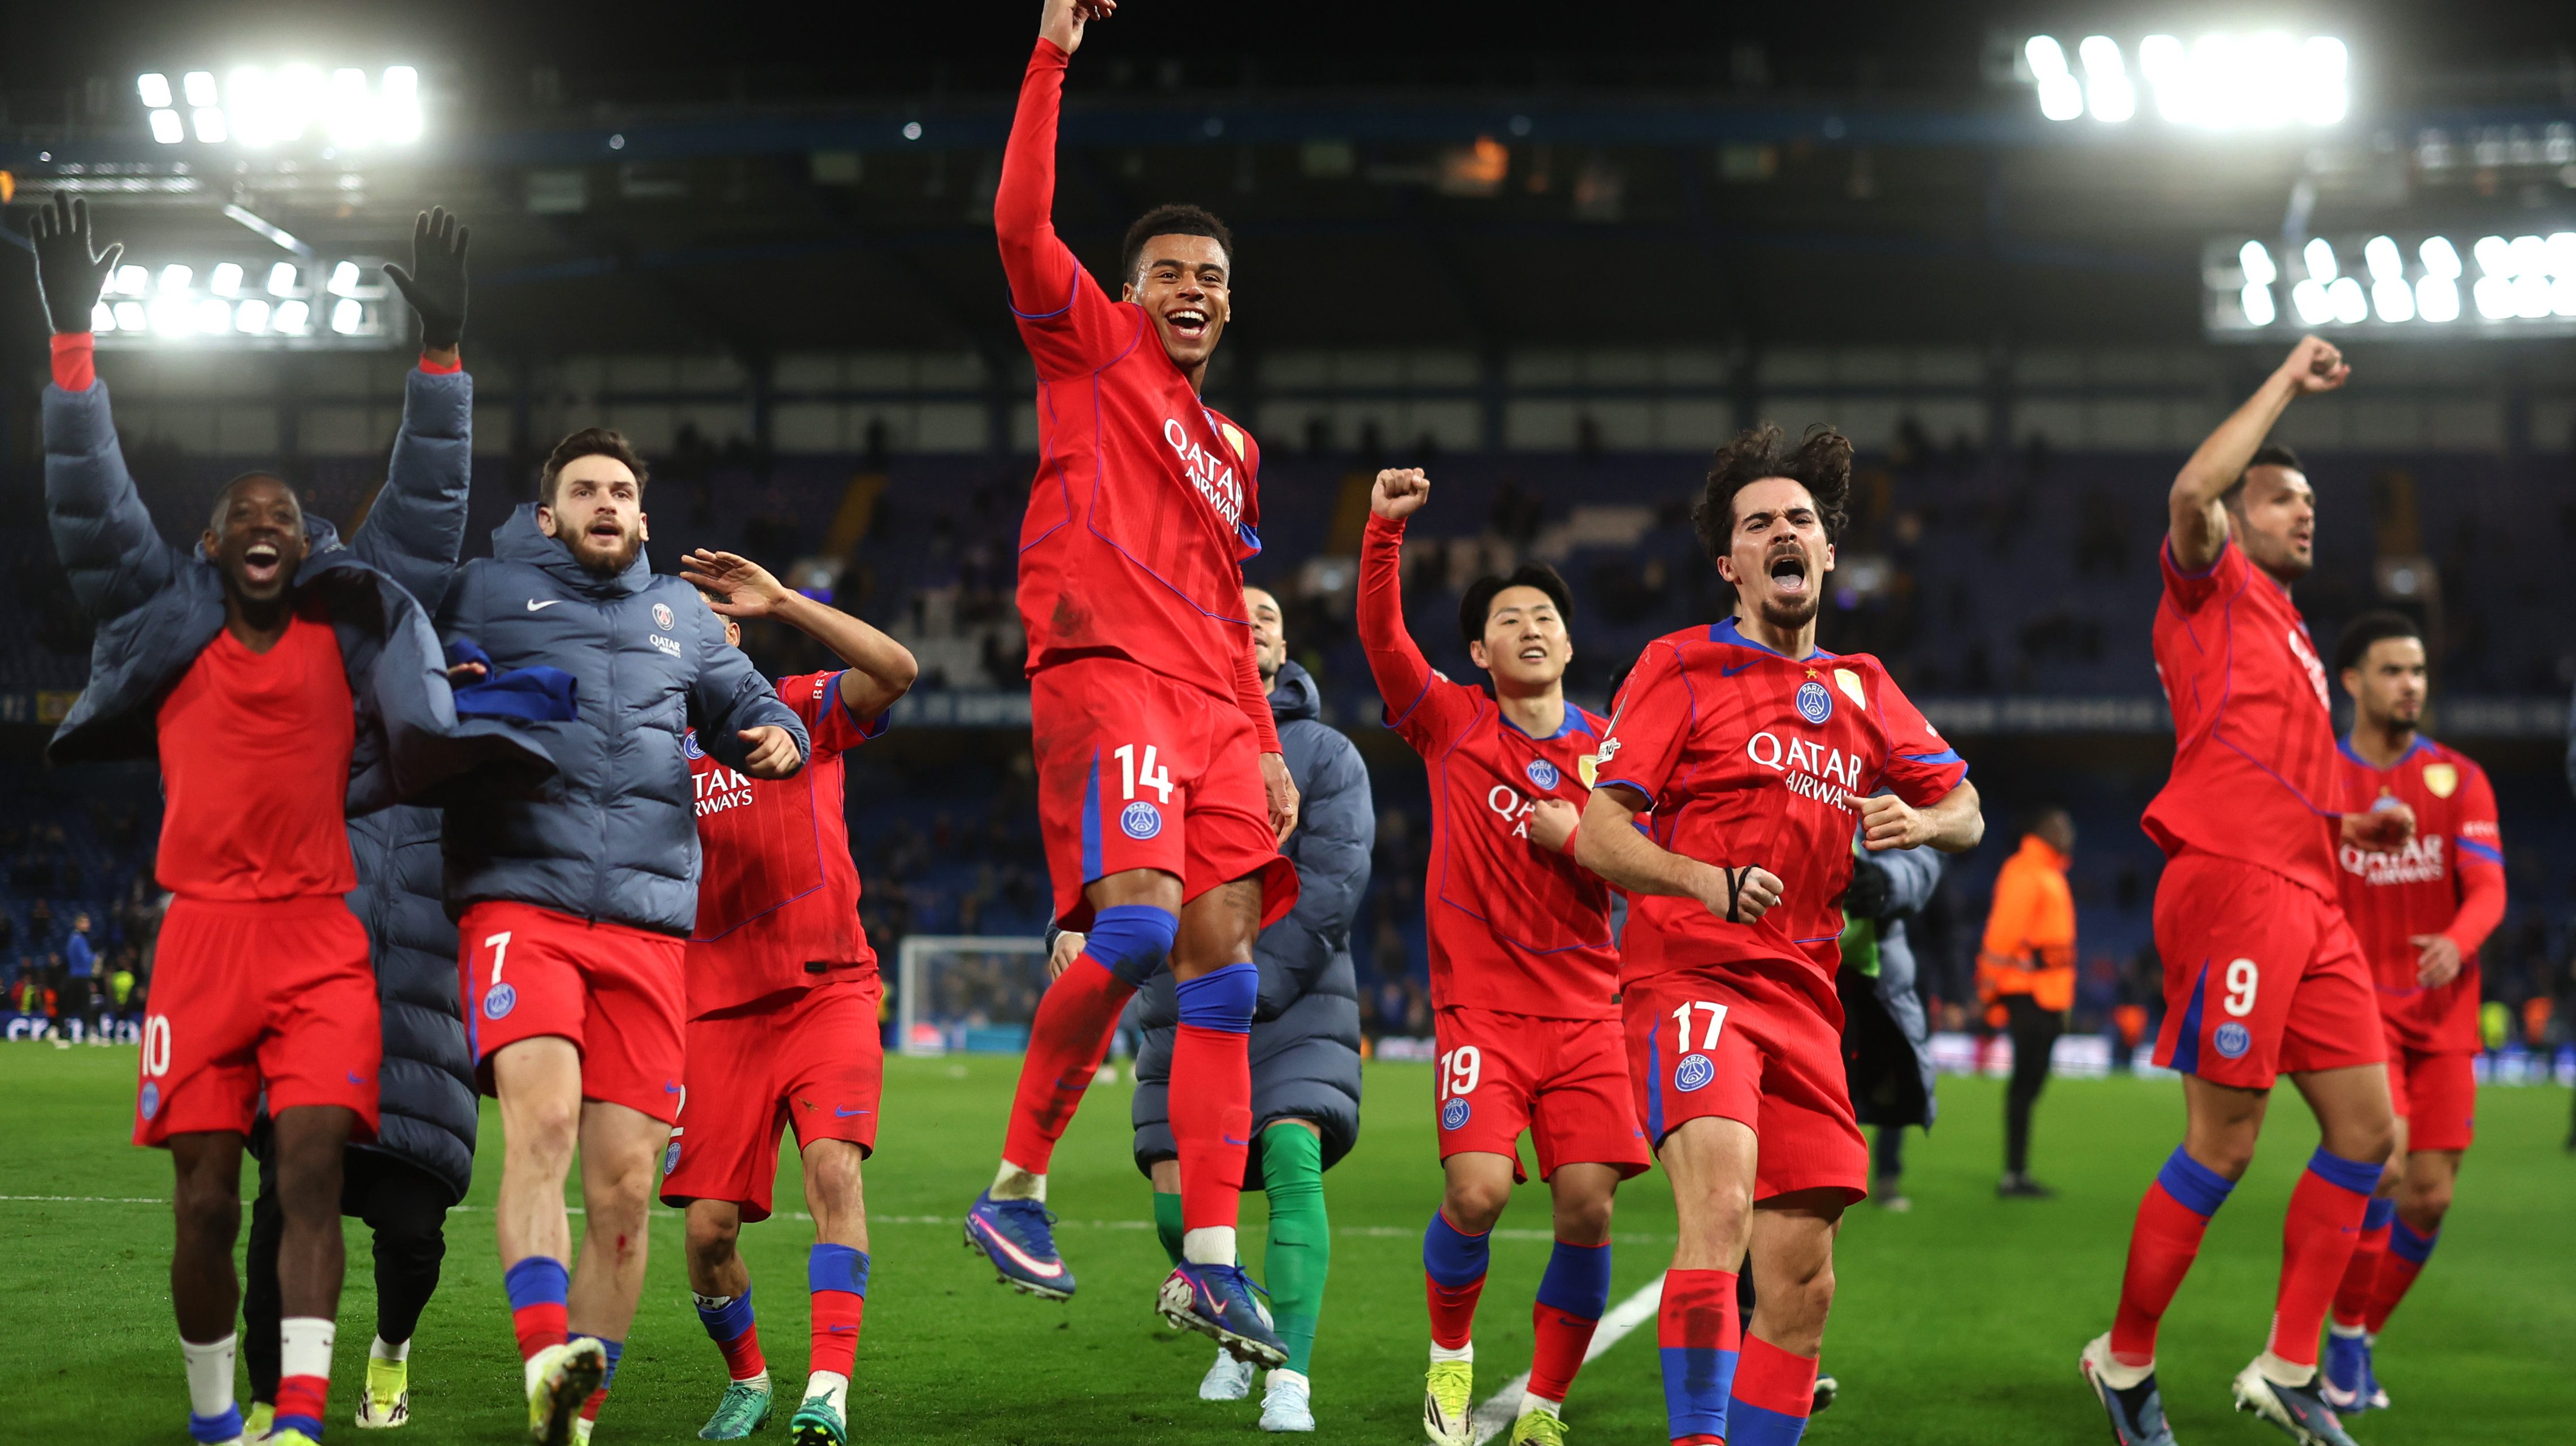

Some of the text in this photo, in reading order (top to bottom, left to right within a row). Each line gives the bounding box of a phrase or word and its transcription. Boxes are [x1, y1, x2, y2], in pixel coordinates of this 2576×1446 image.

[1164, 418, 1243, 508] QATAR
[649, 634, 681, 652] QATAR
[1802, 685, 1825, 696] PARIS
[692, 768, 751, 799] TAR
[1114, 743, 1174, 805] 14
[1530, 761, 1552, 770] PARIS
[1747, 731, 1862, 792] QATAR
[694, 789, 753, 817] RWAYS
[1127, 803, 1154, 815] PARIS
[1785, 769, 1854, 816] AIRWAY
[484, 930, 512, 986] 7
[2223, 957, 2260, 1017] 9
[142, 1014, 171, 1078] 10
[1671, 1000, 1729, 1055] 17
[1441, 1045, 1481, 1101] 19
[1680, 1056, 1706, 1069] PARIS
